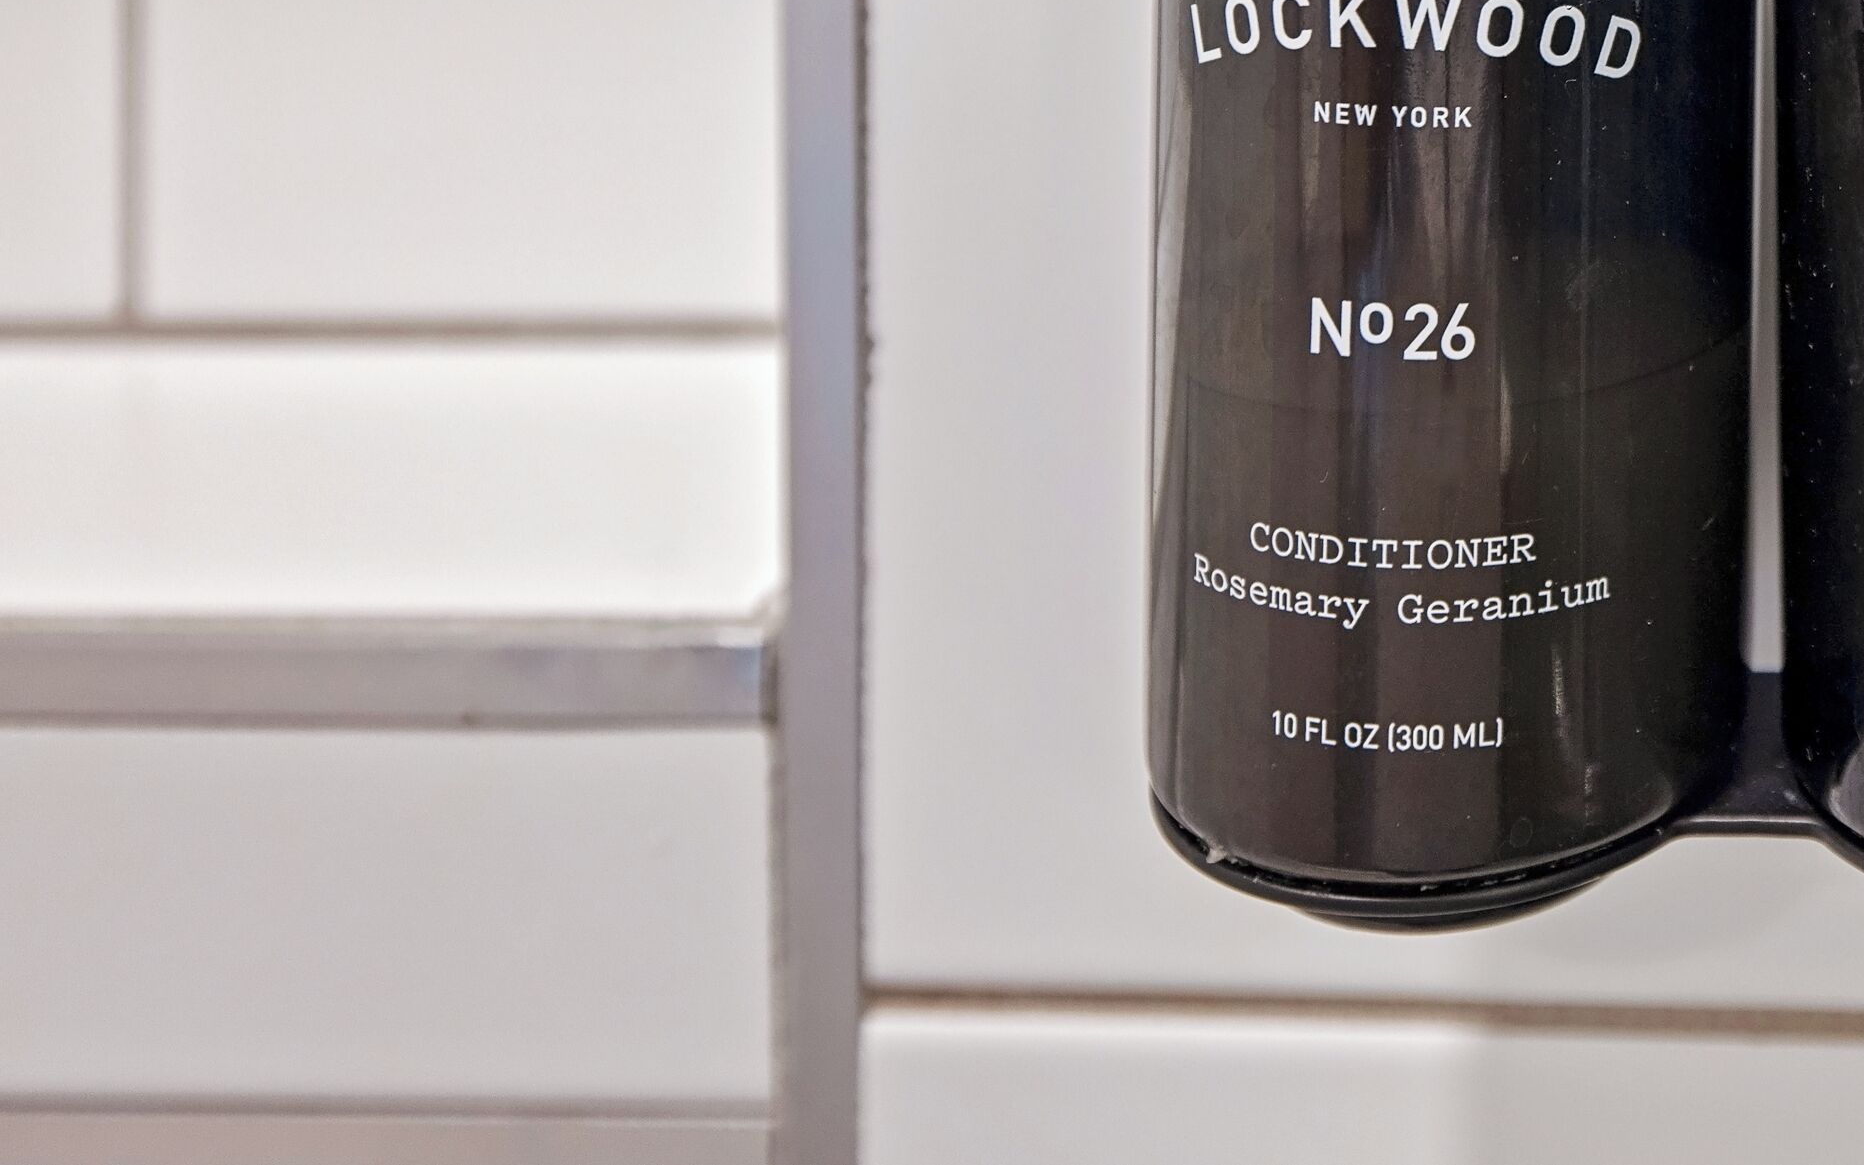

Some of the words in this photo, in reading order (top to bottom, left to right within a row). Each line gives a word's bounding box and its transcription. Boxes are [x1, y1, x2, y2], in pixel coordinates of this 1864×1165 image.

[1313, 101, 1378, 126] NEW
[1391, 106, 1473, 128] YORK
[1250, 521, 1537, 570] CONDITIONER
[1193, 552, 1370, 630] Rosemary
[1397, 577, 1611, 625] Geranium
[1272, 709, 1298, 739] 10
[1304, 716, 1337, 746] FL
[1344, 722, 1380, 750] OZ
